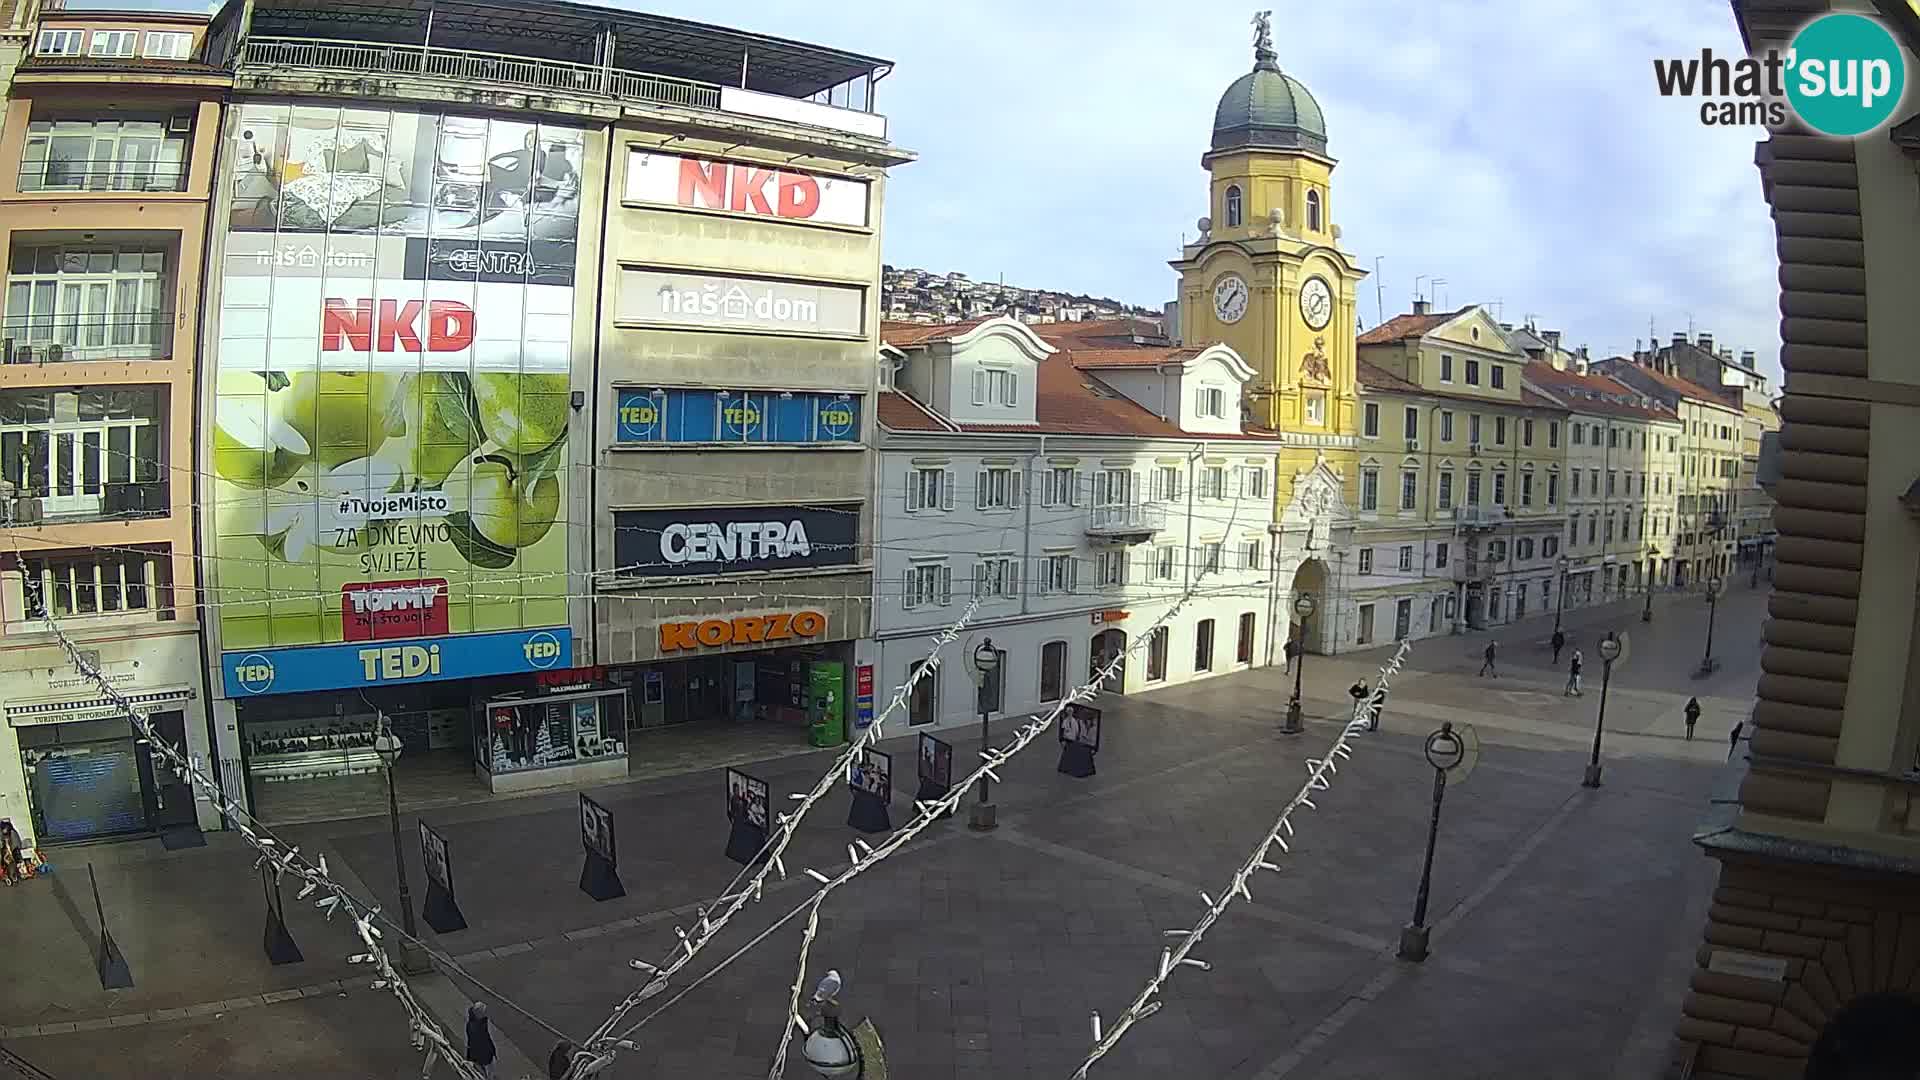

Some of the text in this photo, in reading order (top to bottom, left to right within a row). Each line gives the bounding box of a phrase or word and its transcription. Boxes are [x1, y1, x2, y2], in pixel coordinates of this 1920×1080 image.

[678, 158, 821, 218] NKD
[256, 246, 368, 268] naš dom
[448, 248, 536, 275] CENTRA
[660, 284, 818, 323] naš dom
[322, 297, 477, 352] NKD
[620, 407, 659, 425] TEDi
[723, 407, 761, 425] TEDi
[820, 407, 854, 426] TEDi
[339, 495, 448, 516] #TvojeMisto
[334, 522, 452, 548] ZA DNEVNO
[660, 519, 812, 564] CENTRA
[360, 546, 428, 574] SVJEŽE
[350, 585, 439, 613] TOMMY
[658, 610, 827, 652] KORZO
[359, 643, 441, 681] TEDi
[523, 639, 560, 659] TEDi
[235, 664, 275, 683] TEDi
